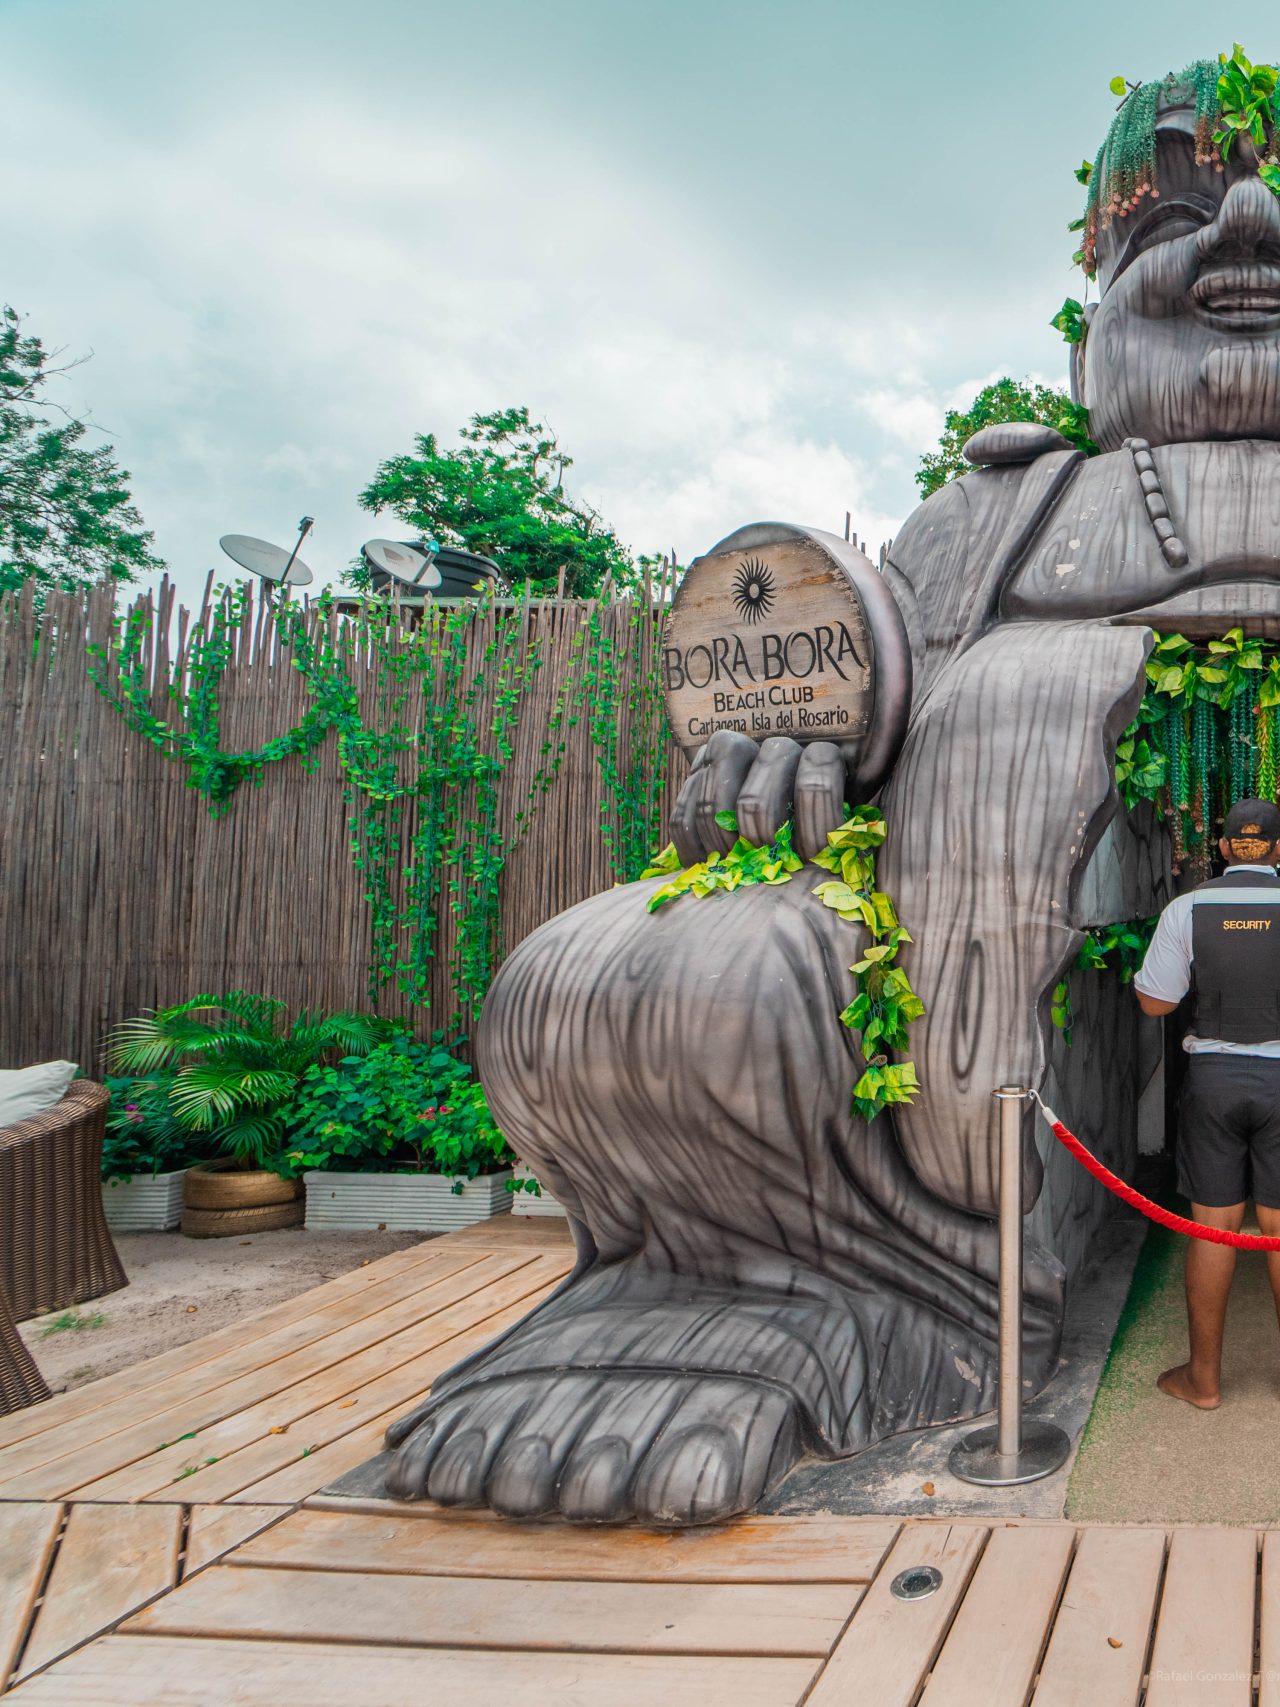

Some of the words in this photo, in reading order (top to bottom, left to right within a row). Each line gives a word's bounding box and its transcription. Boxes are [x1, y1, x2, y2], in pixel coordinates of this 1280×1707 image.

[665, 634, 756, 690] BORA
[762, 621, 866, 681] BORA
[751, 711, 771, 731] Isla
[776, 709, 793, 729] del
[798, 705, 849, 728] Rosario
[1223, 920, 1271, 930] SECURITY
